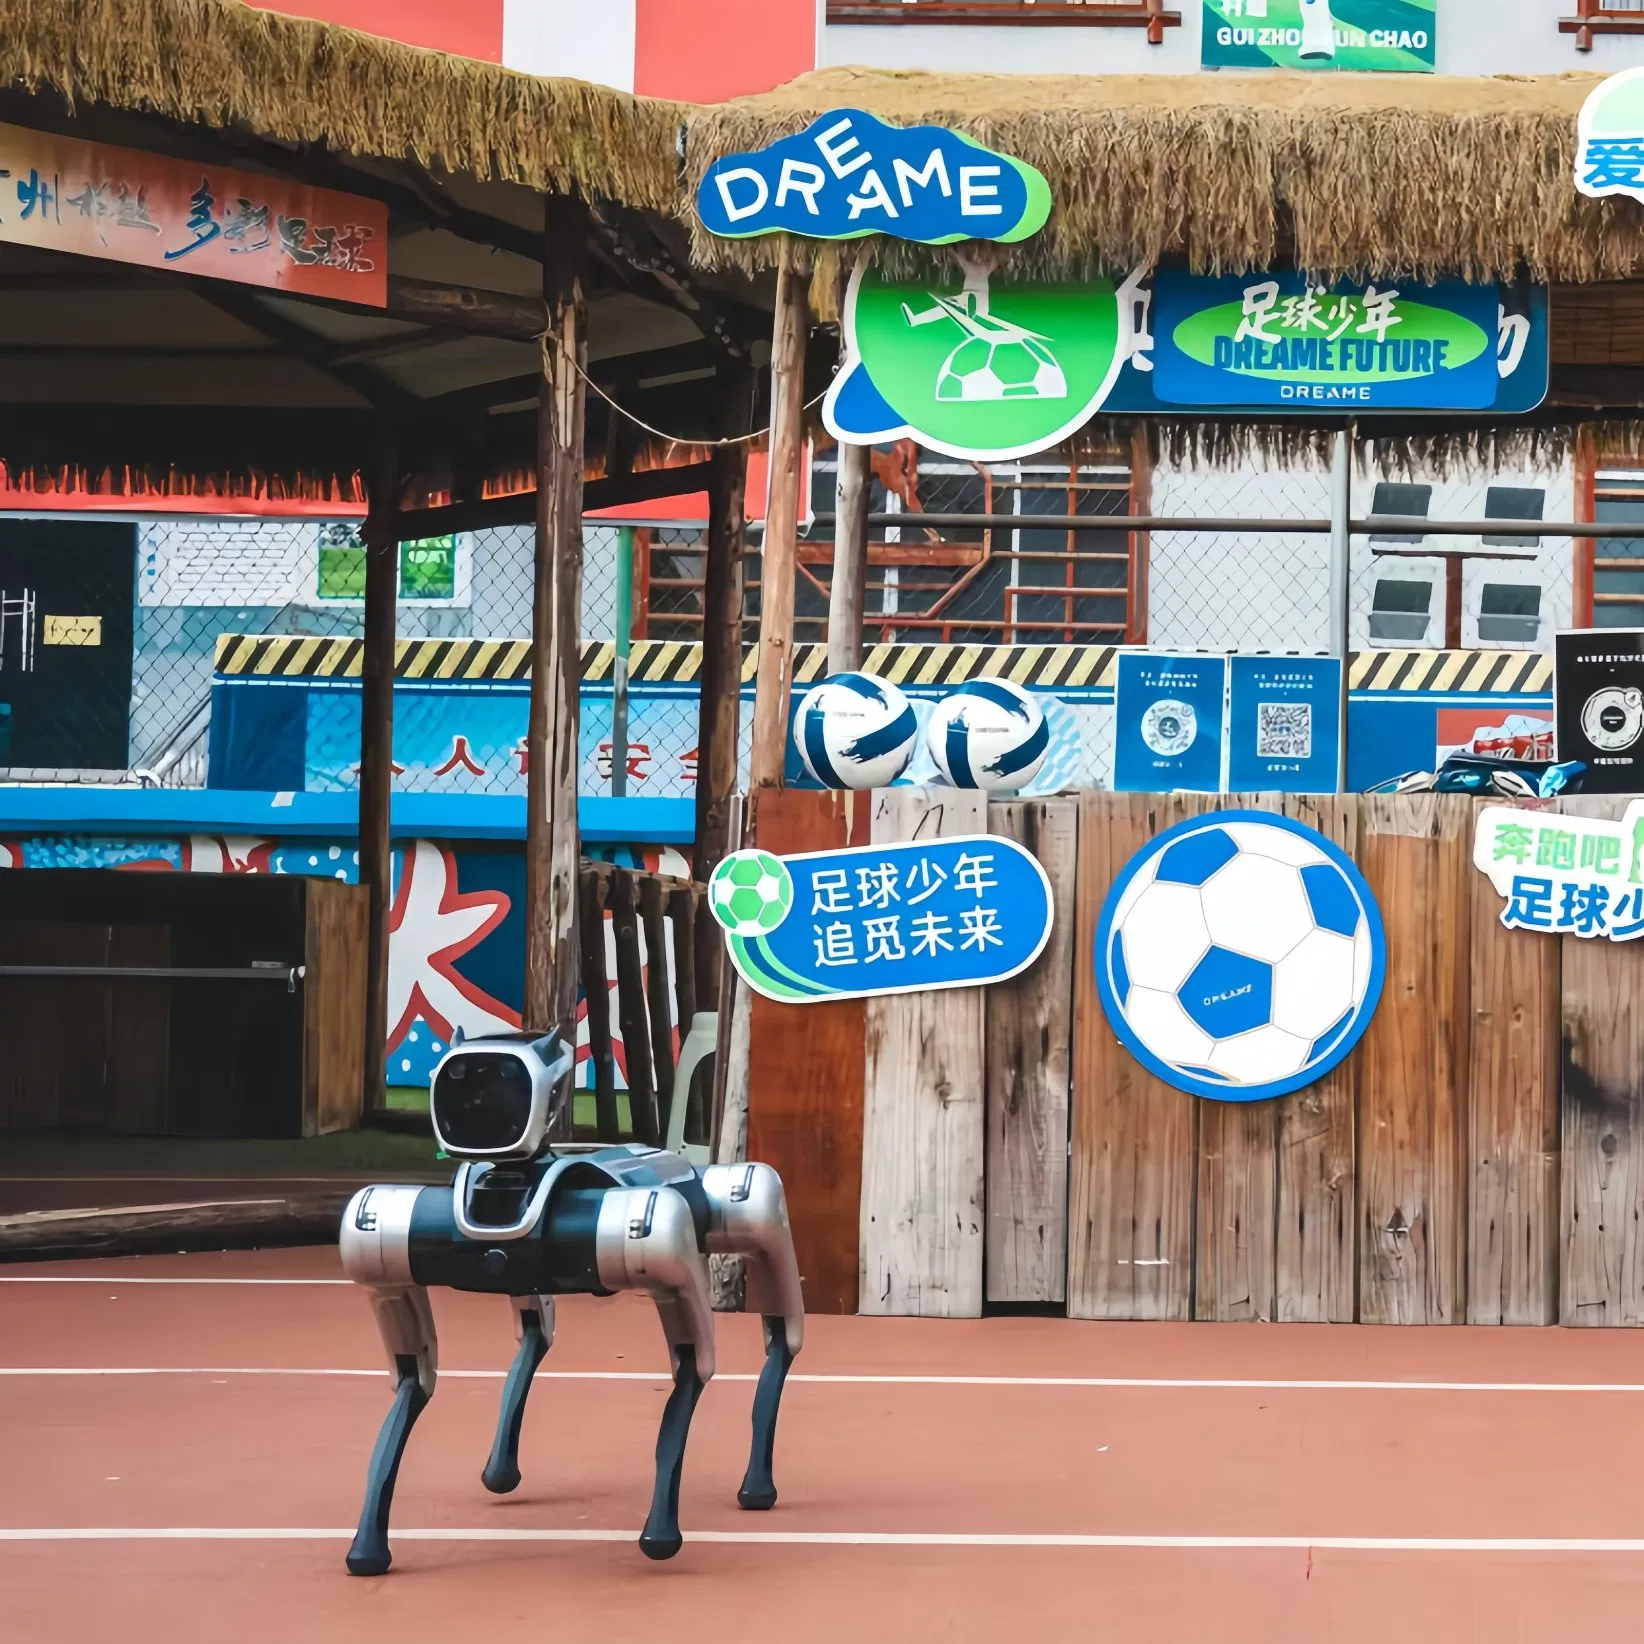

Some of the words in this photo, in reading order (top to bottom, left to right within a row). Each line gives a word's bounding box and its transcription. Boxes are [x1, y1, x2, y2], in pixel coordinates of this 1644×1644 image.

[1257, 27, 1301, 47] ZHO
[1368, 30, 1428, 49] CHAO
[714, 117, 1003, 223] DREAME
[1583, 137, 1644, 189] 爱
[1234, 280, 1403, 344] 足球少年
[1213, 335, 1335, 371] DREAME
[1339, 338, 1450, 373] FUTURE
[1280, 385, 1371, 400] DREAME
[1492, 823, 1621, 875] 奔跑吧
[811, 852, 999, 916] 足球少年
[813, 904, 1004, 968] 追觅未来
